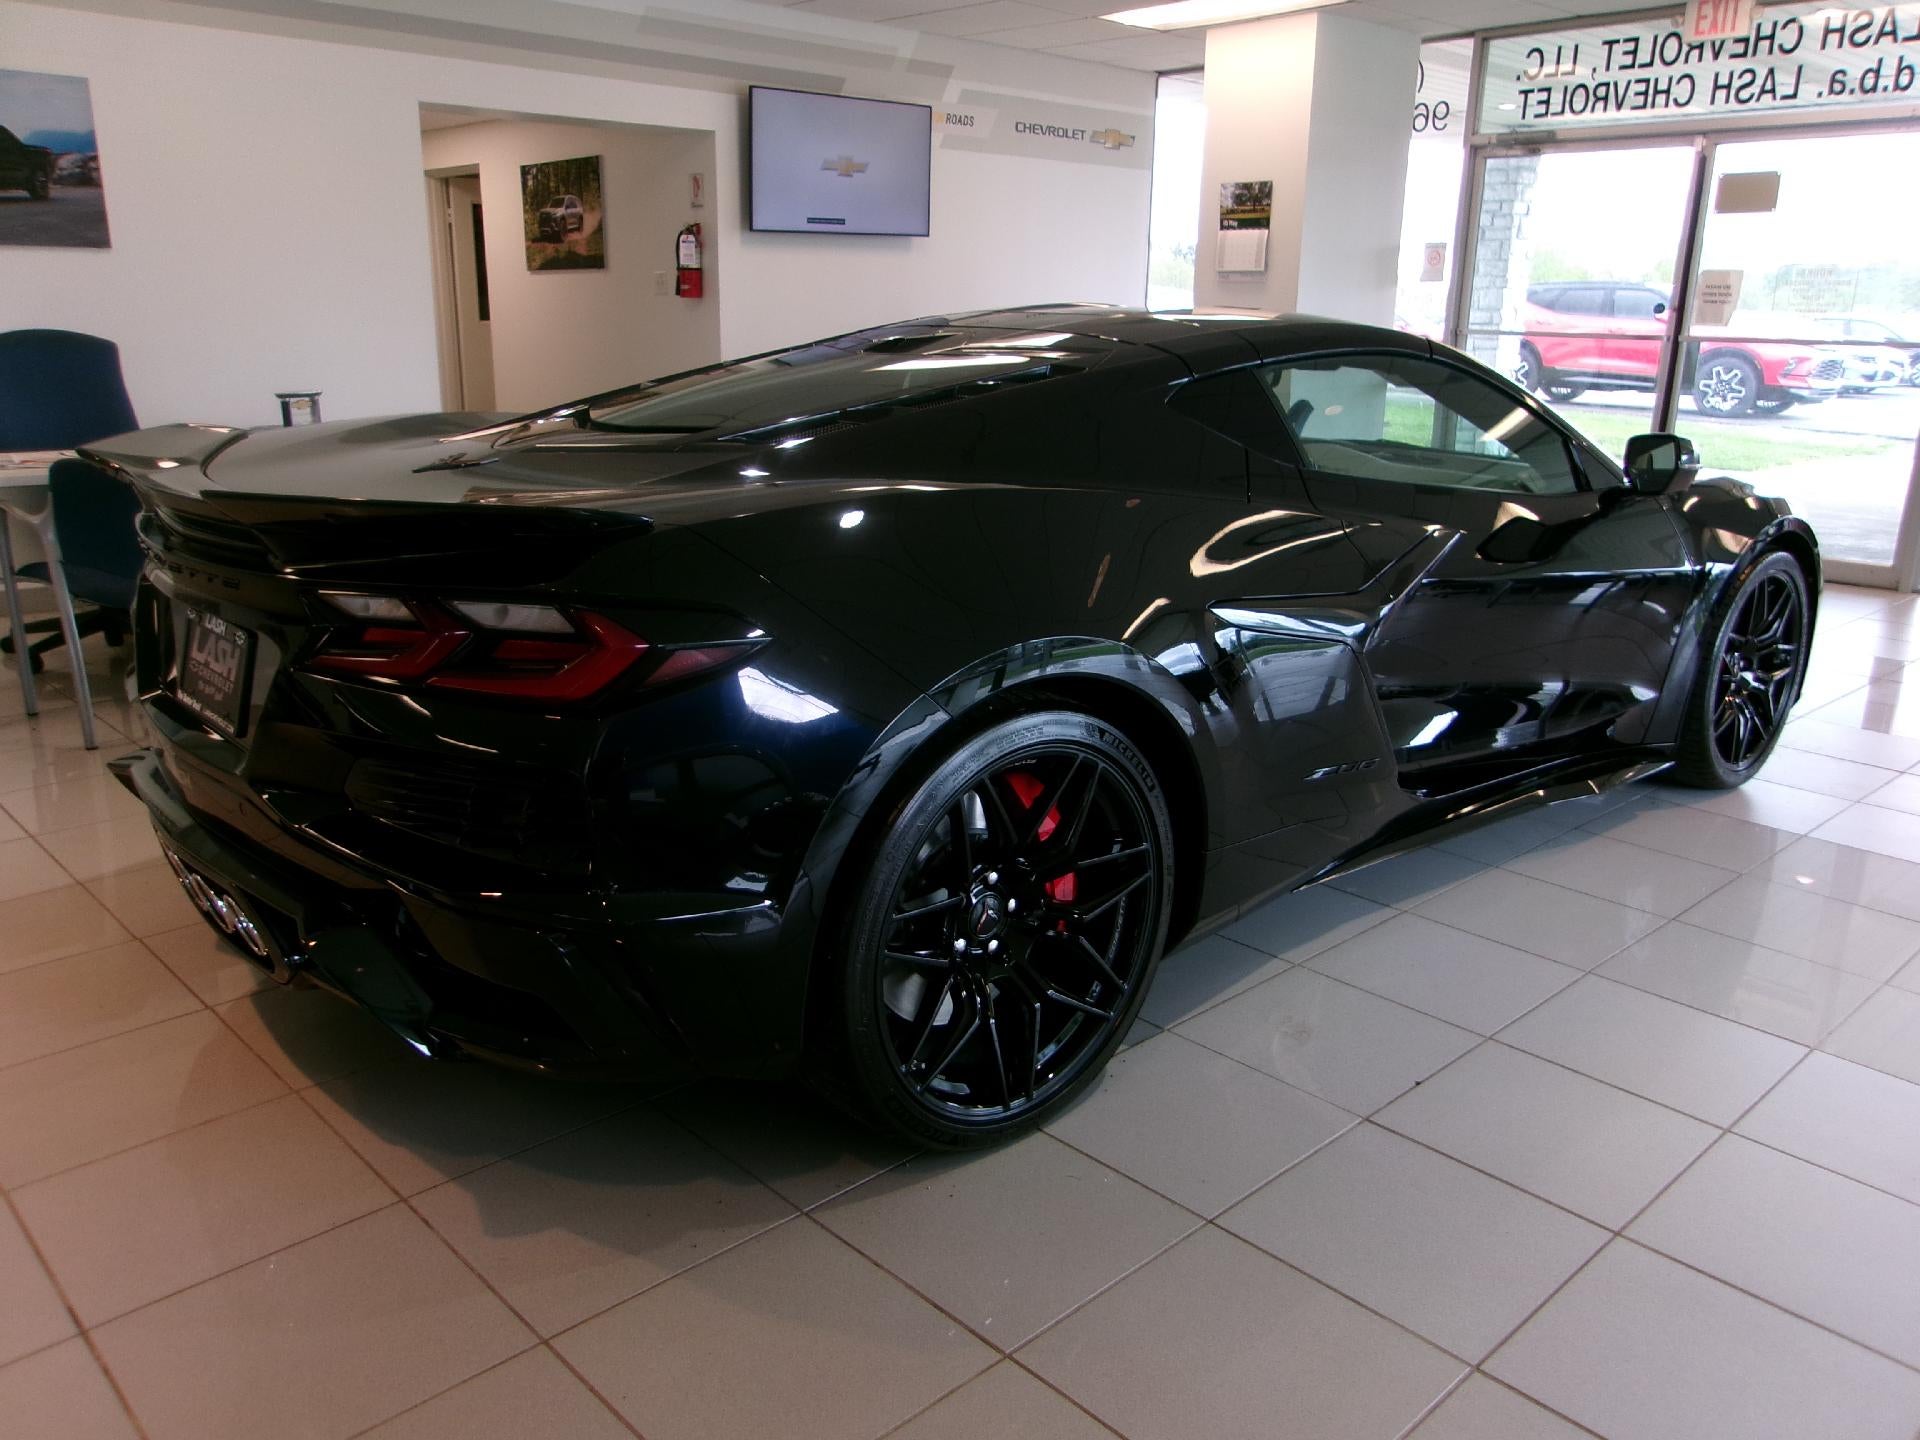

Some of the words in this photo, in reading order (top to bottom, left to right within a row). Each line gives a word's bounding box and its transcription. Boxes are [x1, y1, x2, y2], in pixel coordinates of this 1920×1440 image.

[945, 112, 975, 128] ROADS
[1014, 120, 1087, 142] CHEVROLET
[203, 612, 227, 637] LASH
[191, 624, 239, 681] LASH
[1102, 730, 1154, 788] MICHELIN
